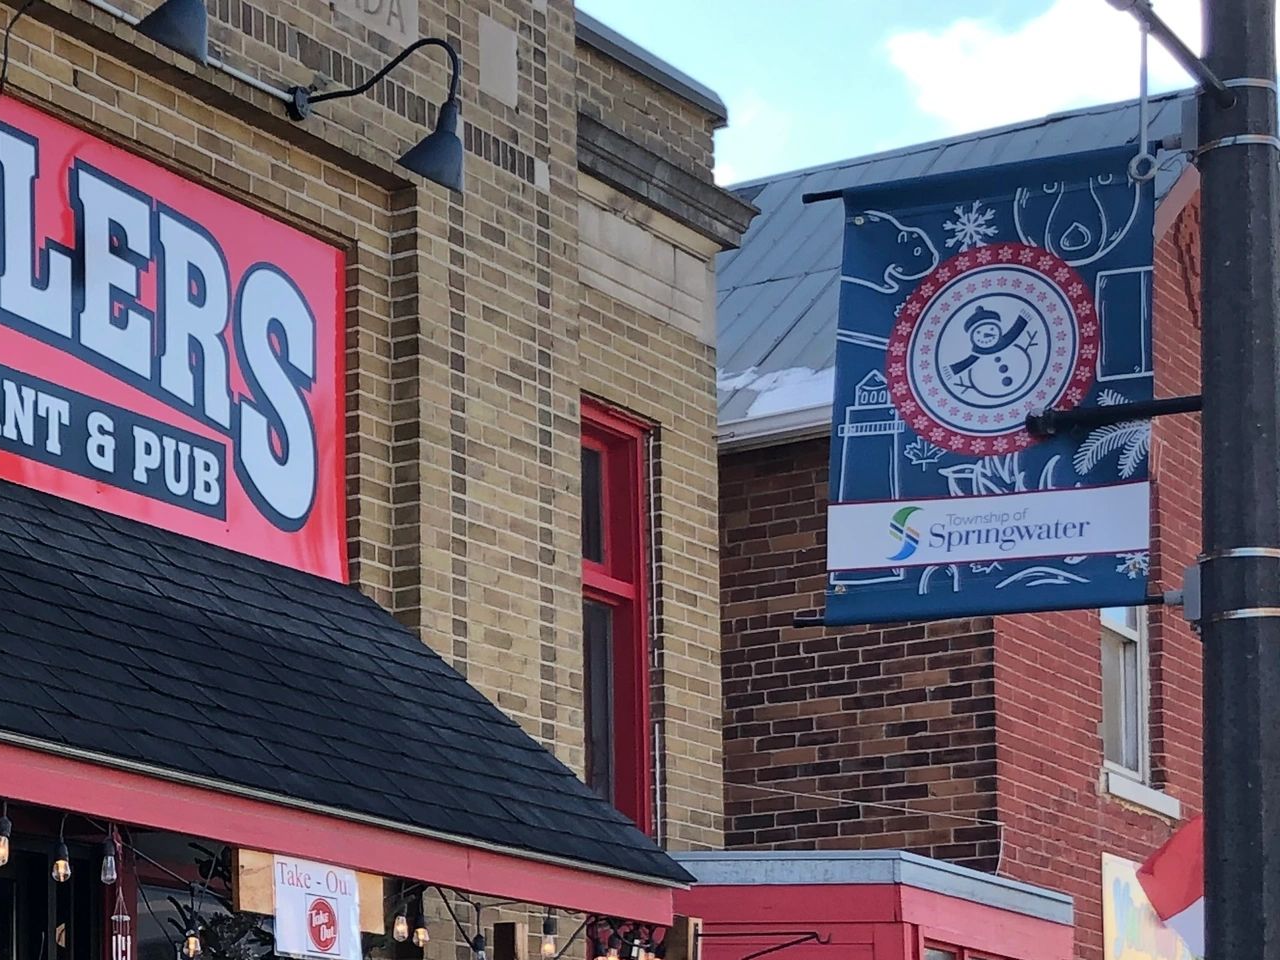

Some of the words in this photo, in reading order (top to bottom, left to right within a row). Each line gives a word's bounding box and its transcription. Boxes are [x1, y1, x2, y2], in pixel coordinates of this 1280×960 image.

[87, 413, 115, 472] &
[133, 424, 221, 506] PUB
[946, 510, 1010, 526] Township
[1013, 508, 1029, 522] of
[928, 519, 1091, 552] Springwater
[276, 861, 312, 889] Take
[325, 870, 352, 897] Ou
